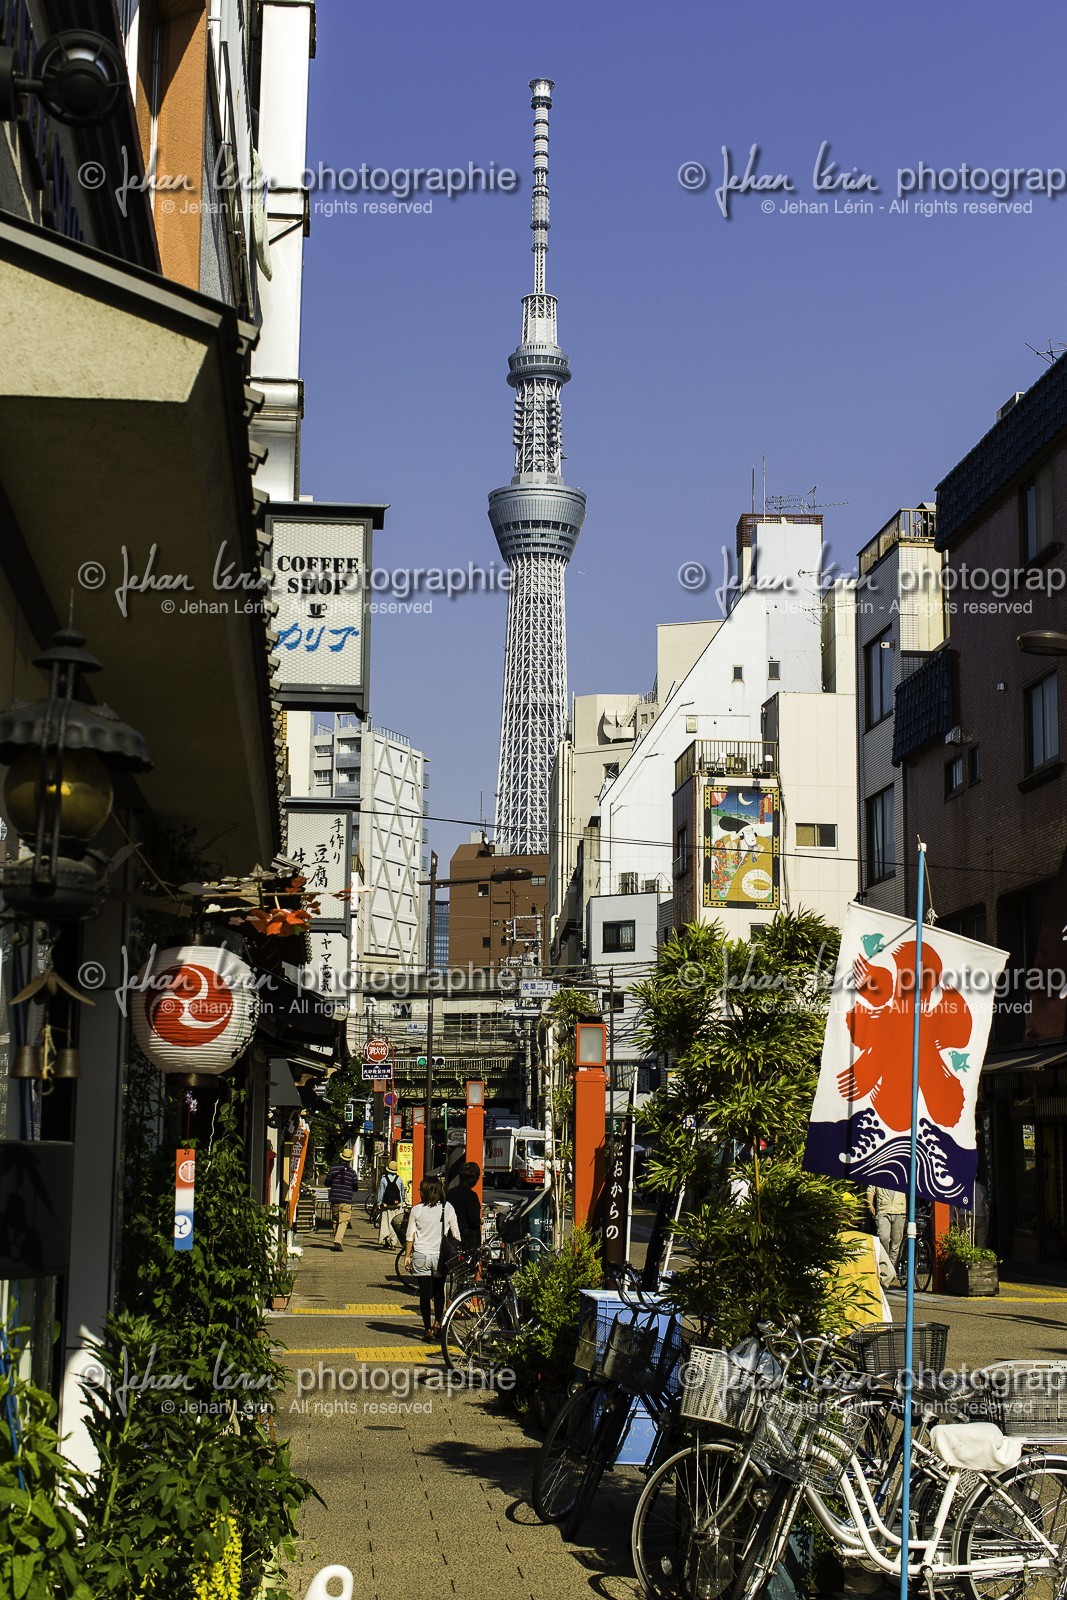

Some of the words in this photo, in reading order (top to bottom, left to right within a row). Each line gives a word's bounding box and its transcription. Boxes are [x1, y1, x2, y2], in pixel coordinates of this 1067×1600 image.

[277, 555, 359, 574] COFFEE
[287, 577, 348, 595] SHOP
[329, 817, 344, 864] 手作り
[308, 844, 329, 888] 豆腐
[320, 932, 332, 993] ヤマ電気
